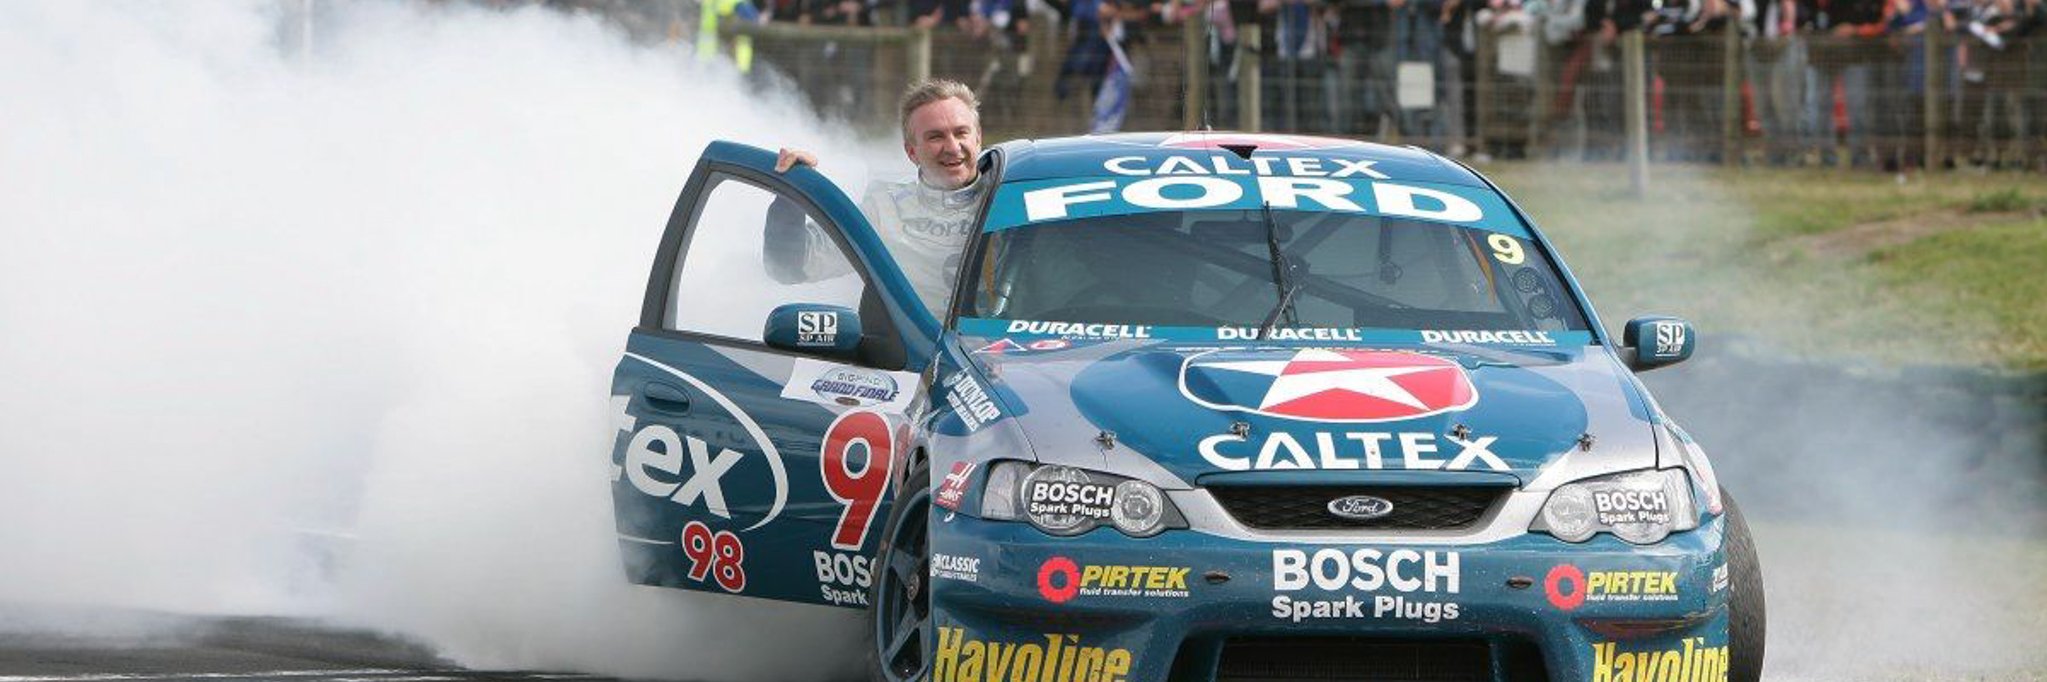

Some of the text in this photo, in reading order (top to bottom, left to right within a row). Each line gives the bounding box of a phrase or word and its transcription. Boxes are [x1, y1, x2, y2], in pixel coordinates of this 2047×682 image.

[1104, 155, 1391, 180] CALTEX
[1023, 175, 1484, 223] FORD
[1487, 233, 1525, 265] 9
[800, 313, 836, 333] SP
[1007, 320, 1151, 338] DURACELL
[1659, 324, 1684, 344] SP
[1421, 329, 1555, 344] DURACELL
[953, 374, 1001, 424] DUNLOP
[611, 395, 744, 519] tex
[1198, 431, 1513, 471] CALTEX
[820, 407, 895, 551] 9
[1032, 482, 1114, 505] BOSCH
[1342, 498, 1379, 513] Ford
[1594, 491, 1667, 511] BOSCH
[1030, 502, 1110, 519] Spark Plugs
[1599, 511, 1670, 525] Spark Plugs
[682, 520, 746, 593] 98
[941, 554, 981, 573] CLASSIC
[813, 550, 876, 588] BOS
[1080, 565, 1191, 590] PIRTEK
[1272, 548, 1460, 593] BOSCH
[1080, 588, 1189, 598] fluid transfer solutions
[1587, 571, 1679, 594] PIRTEK
[820, 584, 869, 606] Spark
[1272, 595, 1460, 623] Spark Plugs
[933, 626, 1131, 682] Havoline
